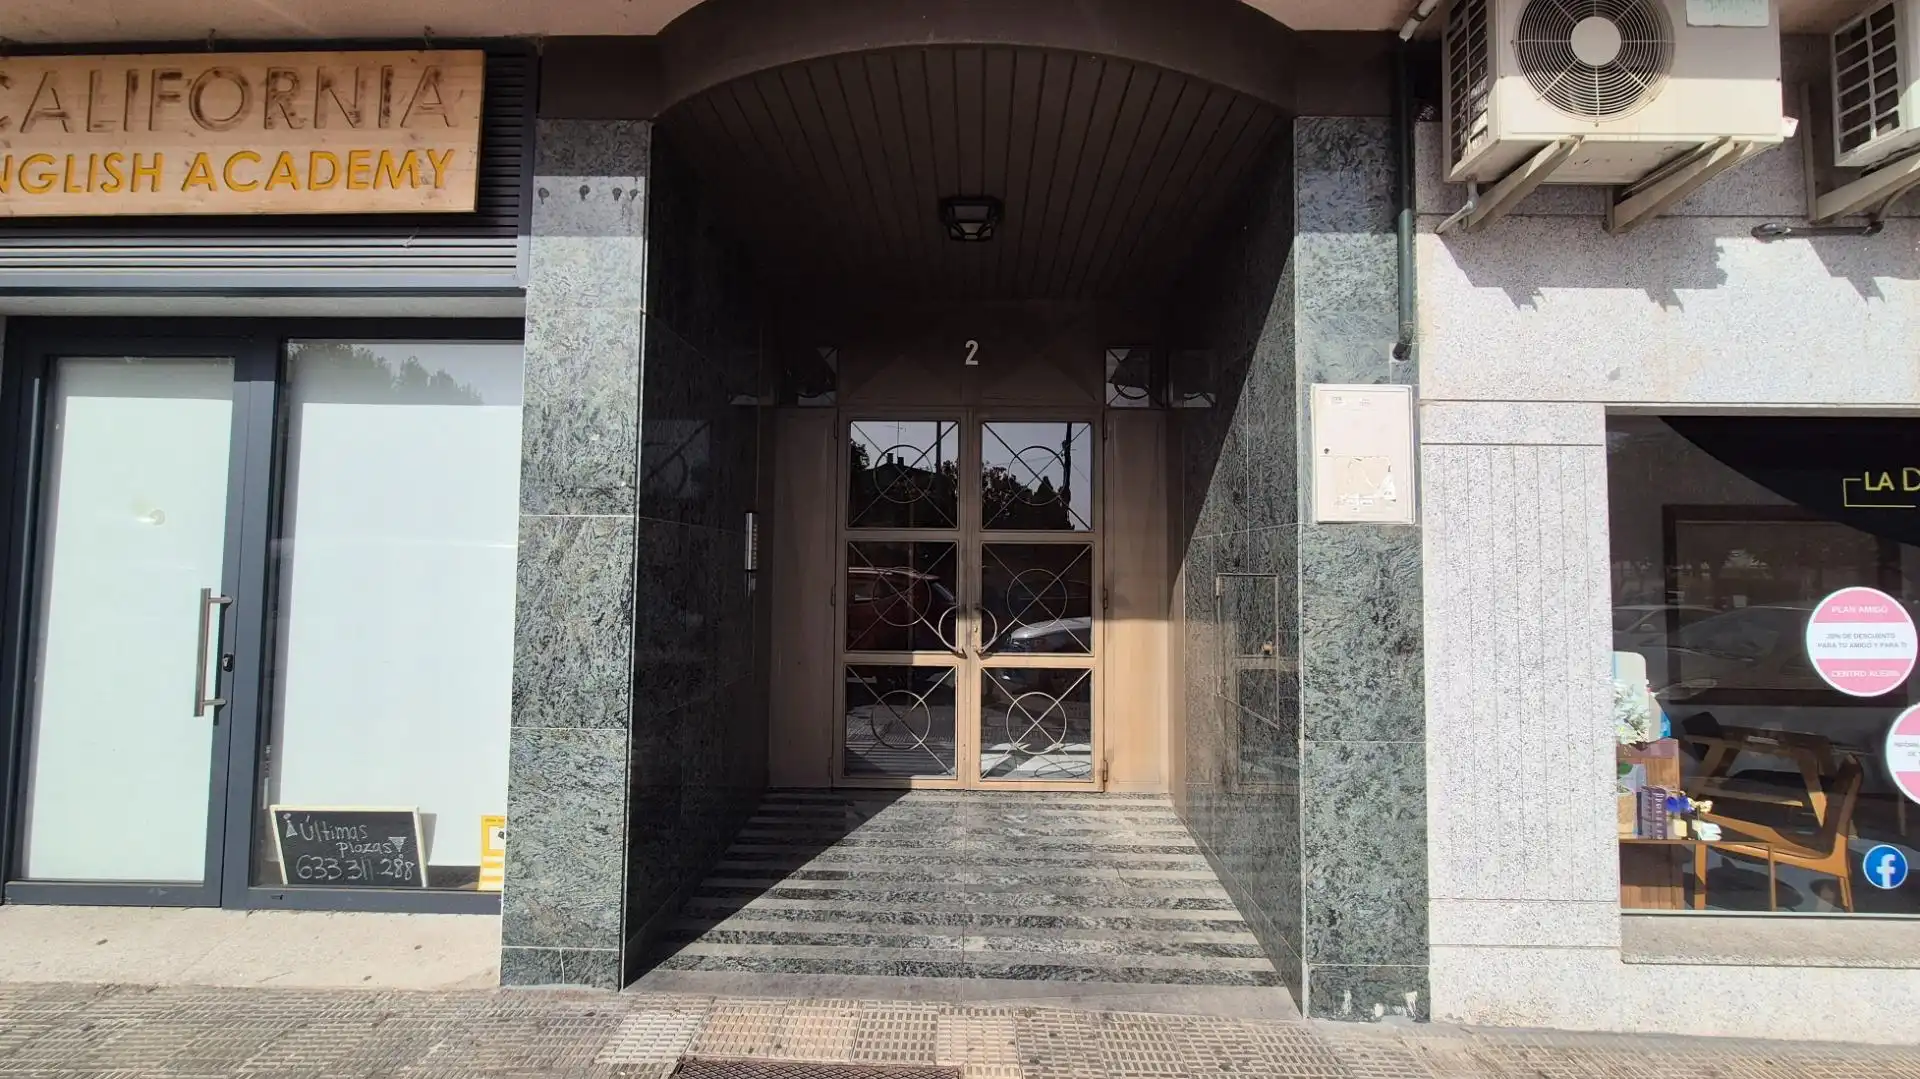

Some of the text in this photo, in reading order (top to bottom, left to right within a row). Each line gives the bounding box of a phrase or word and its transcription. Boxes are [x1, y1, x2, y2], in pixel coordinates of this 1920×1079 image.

[181, 149, 455, 193] ACADEMY
[965, 340, 979, 365] 2
[1864, 471, 1895, 491] LA
[1831, 605, 1888, 614] PLAN AMIGO
[299, 815, 368, 842] Últimas
